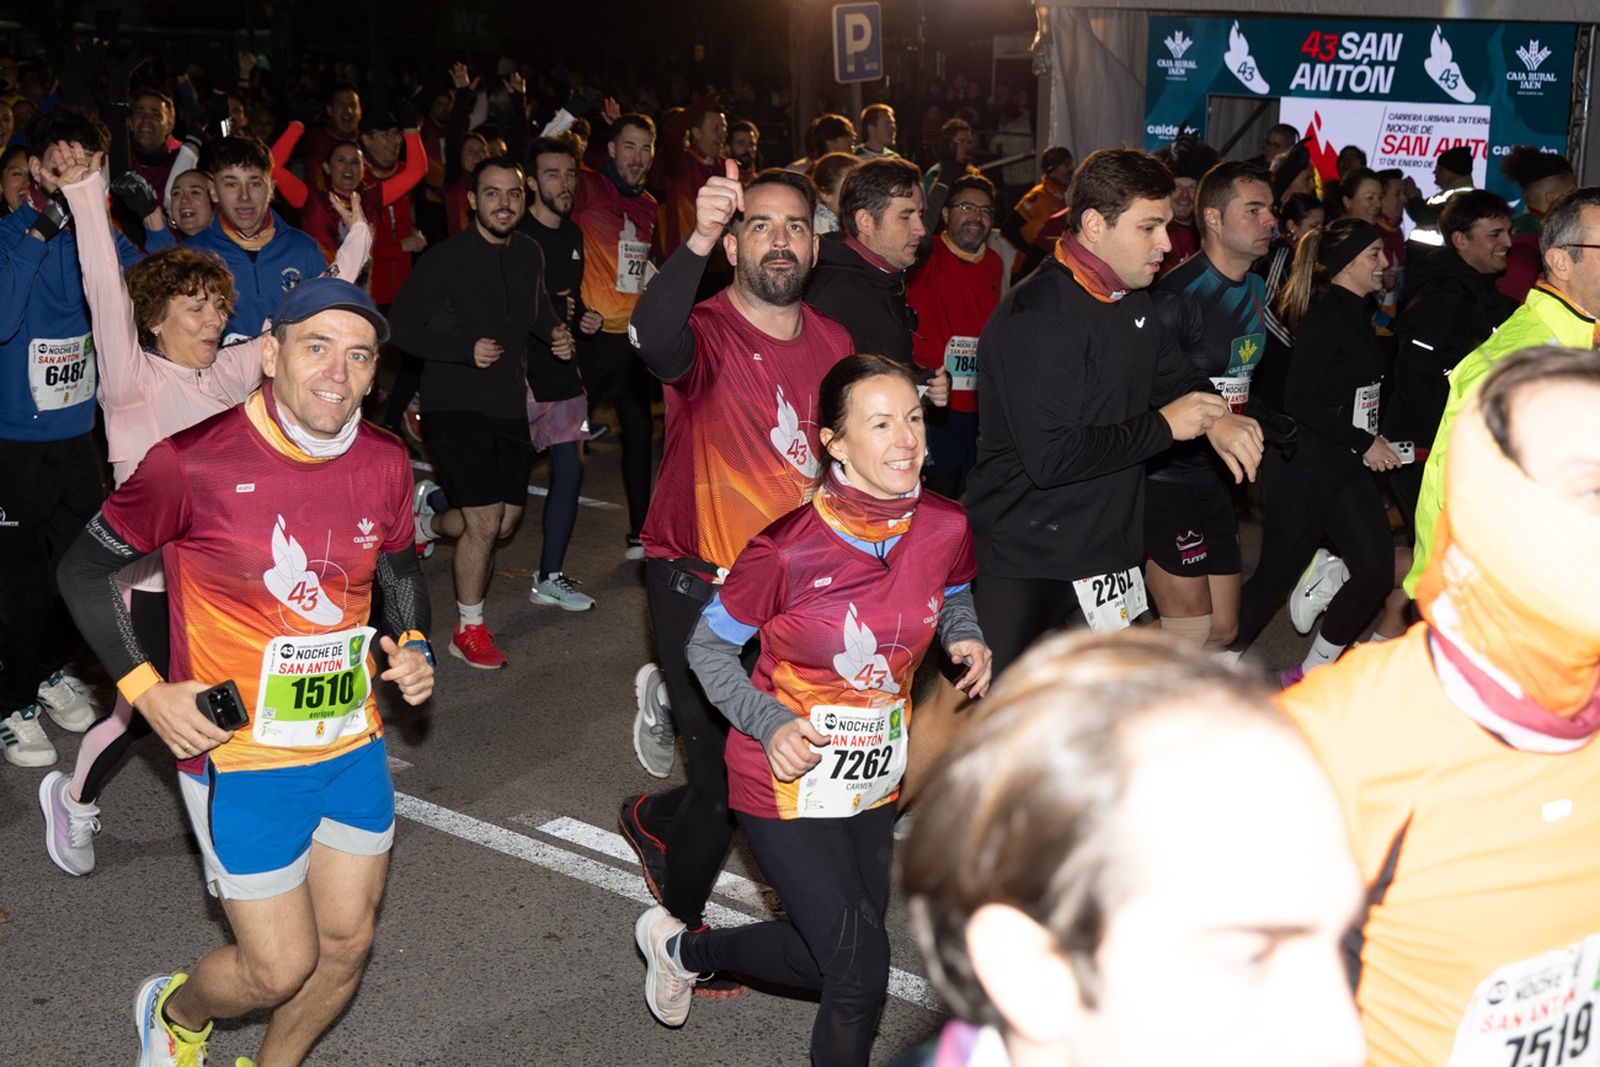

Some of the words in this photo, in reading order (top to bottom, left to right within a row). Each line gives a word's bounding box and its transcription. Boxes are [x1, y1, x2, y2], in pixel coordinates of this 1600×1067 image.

[845, 13, 872, 73] P
[1301, 29, 1339, 62] 43
[1338, 31, 1404, 62] SAN
[1237, 61, 1255, 82] 43
[1289, 57, 1396, 94] ANTÓN
[1439, 68, 1460, 90] 43
[1388, 113, 1424, 122] CARRERA
[1424, 115, 1455, 123] URBANA
[1386, 124, 1419, 134] NOCHE
[1420, 125, 1434, 135] DE
[1381, 135, 1430, 157] SAN
[1387, 158, 1396, 166] DE
[1398, 159, 1423, 167] ENERO
[38, 355, 55, 364] SAN
[45, 358, 87, 387] 6487
[1367, 408, 1378, 428] 15
[787, 439, 807, 466] 43
[288, 581, 318, 612] 43
[296, 647, 330, 659] NOCHE
[332, 645, 343, 656] DE
[279, 662, 304, 674] SAN
[854, 664, 888, 688] 43
[292, 671, 354, 709] 1510
[309, 709, 335, 719] enrique
[839, 720, 875, 733] NOCHE
[830, 745, 893, 780] 7262
[845, 781, 873, 790] CARMEN
[1480, 1011, 1523, 1034] SAN
[1506, 1001, 1593, 1067] 7519
